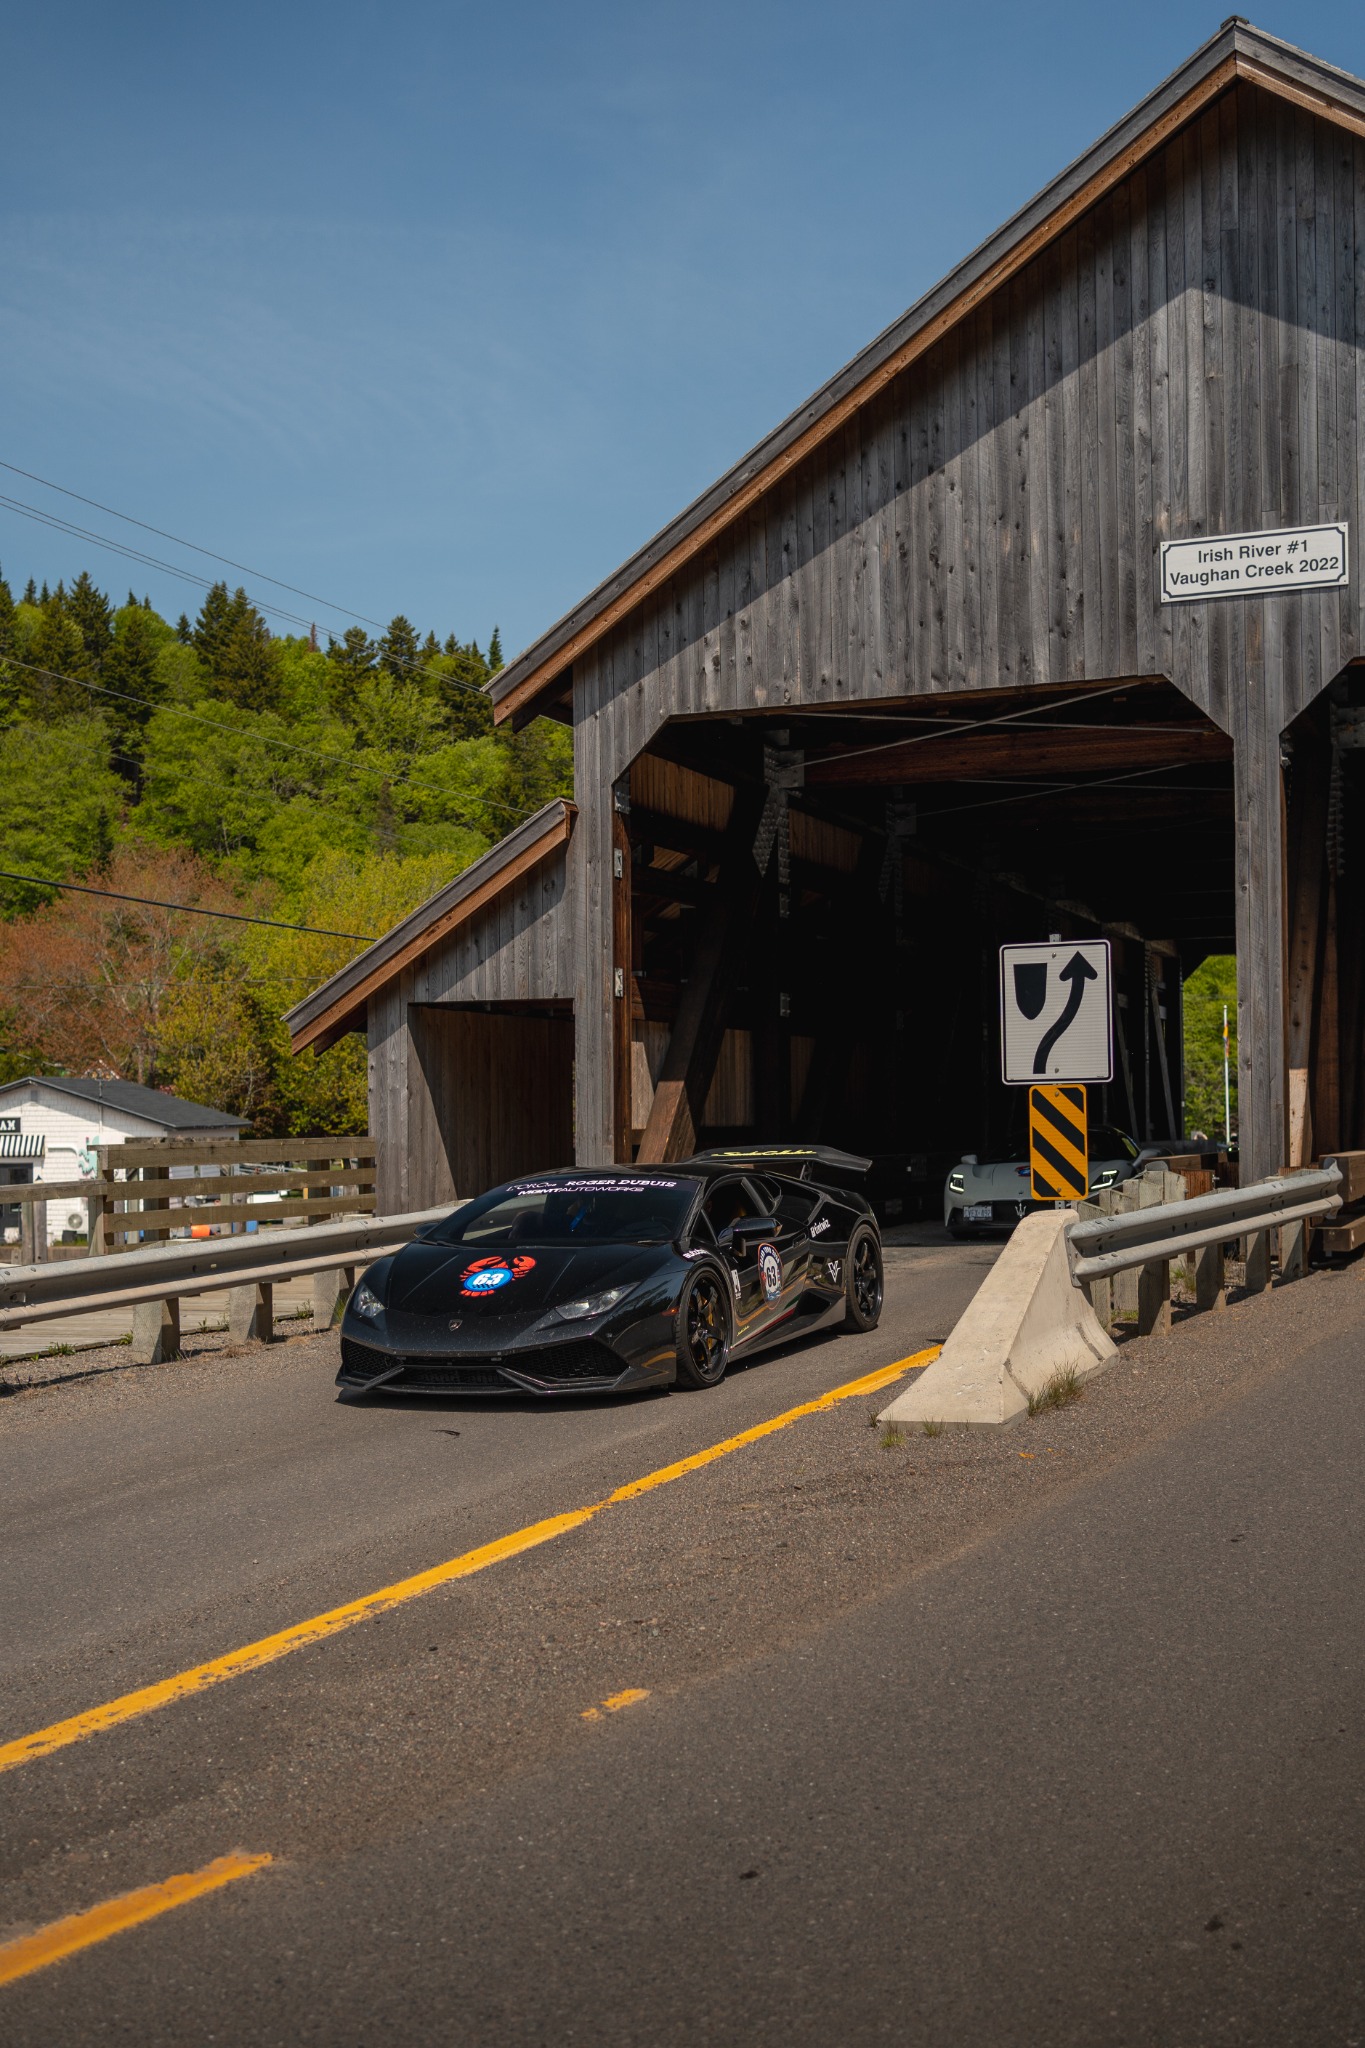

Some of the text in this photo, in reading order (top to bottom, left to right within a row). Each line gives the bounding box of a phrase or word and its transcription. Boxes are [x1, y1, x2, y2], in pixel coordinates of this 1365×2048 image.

[1198, 539, 1308, 563] Irish River #1
[1170, 556, 1339, 586] Vaughan Creek 2022
[565, 1179, 677, 1188] ROGER DUBUIS
[473, 1273, 505, 1285] 63
[766, 1265, 777, 1288] 63
